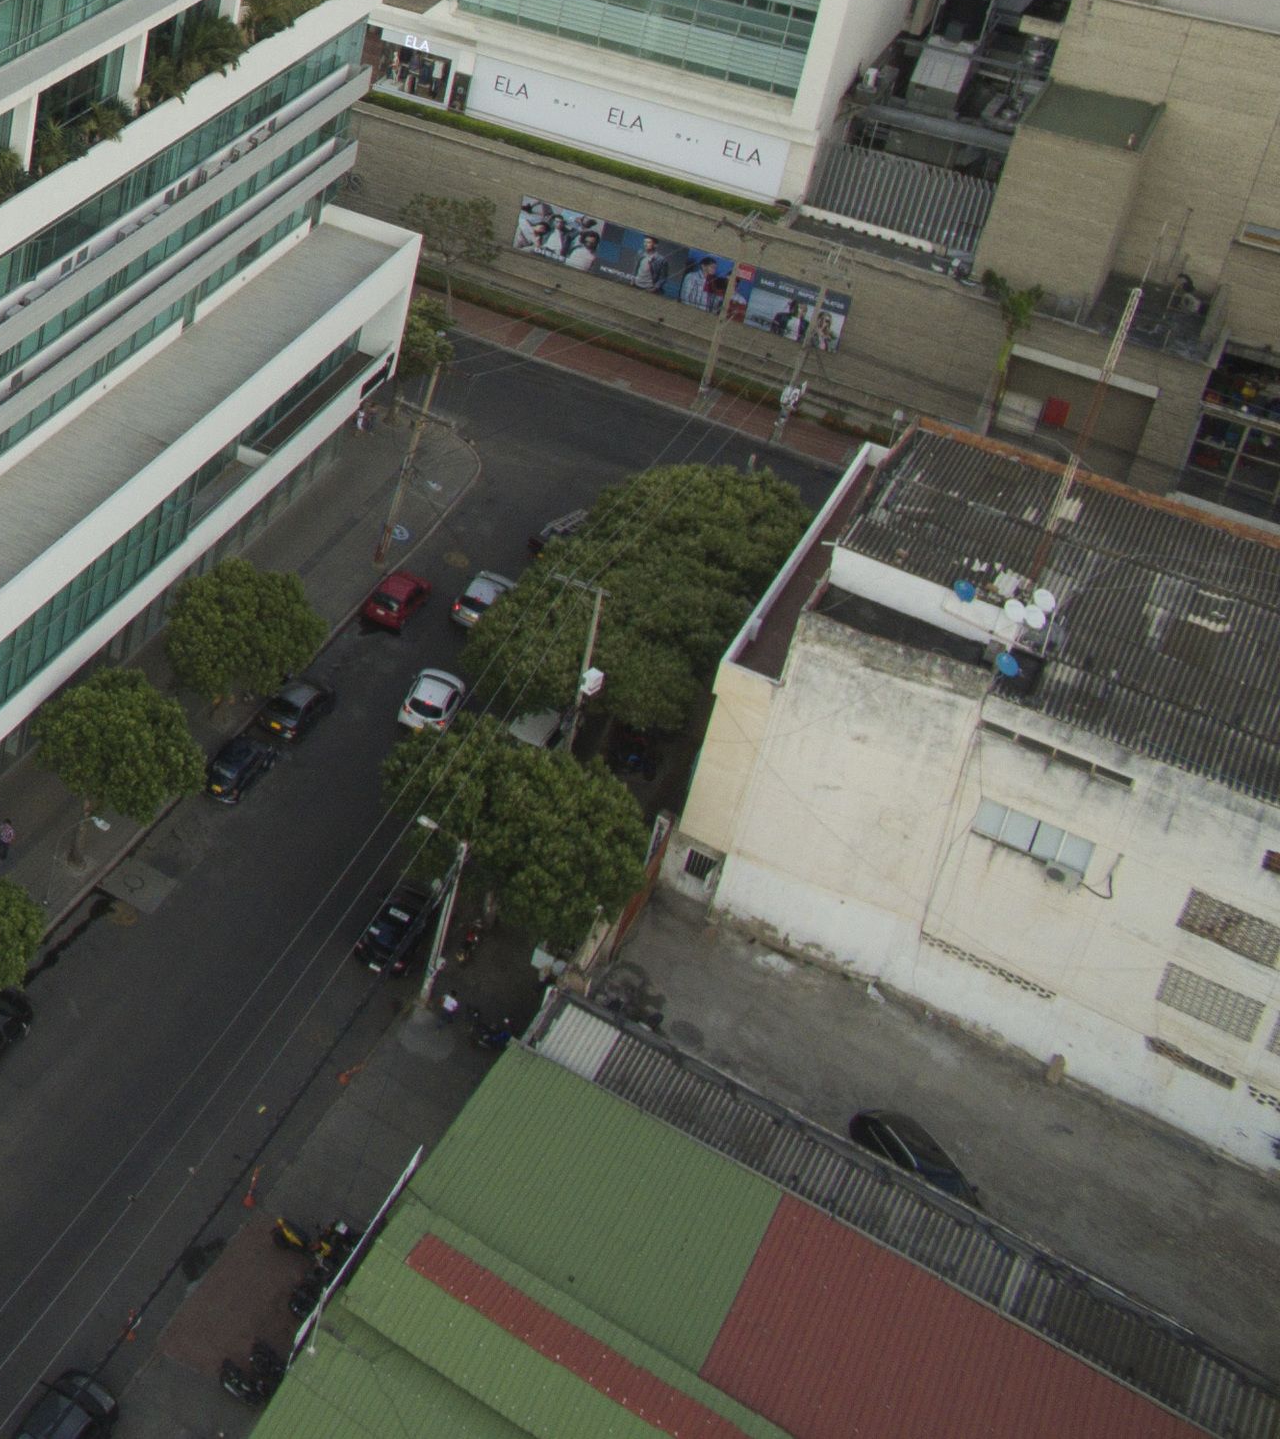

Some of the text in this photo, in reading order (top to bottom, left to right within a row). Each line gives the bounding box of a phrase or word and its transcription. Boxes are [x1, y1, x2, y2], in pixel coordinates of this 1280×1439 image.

[405, 34, 430, 53] ELA
[494, 74, 529, 99] ELA
[607, 106, 644, 132] ELA
[722, 139, 762, 166] ELA
